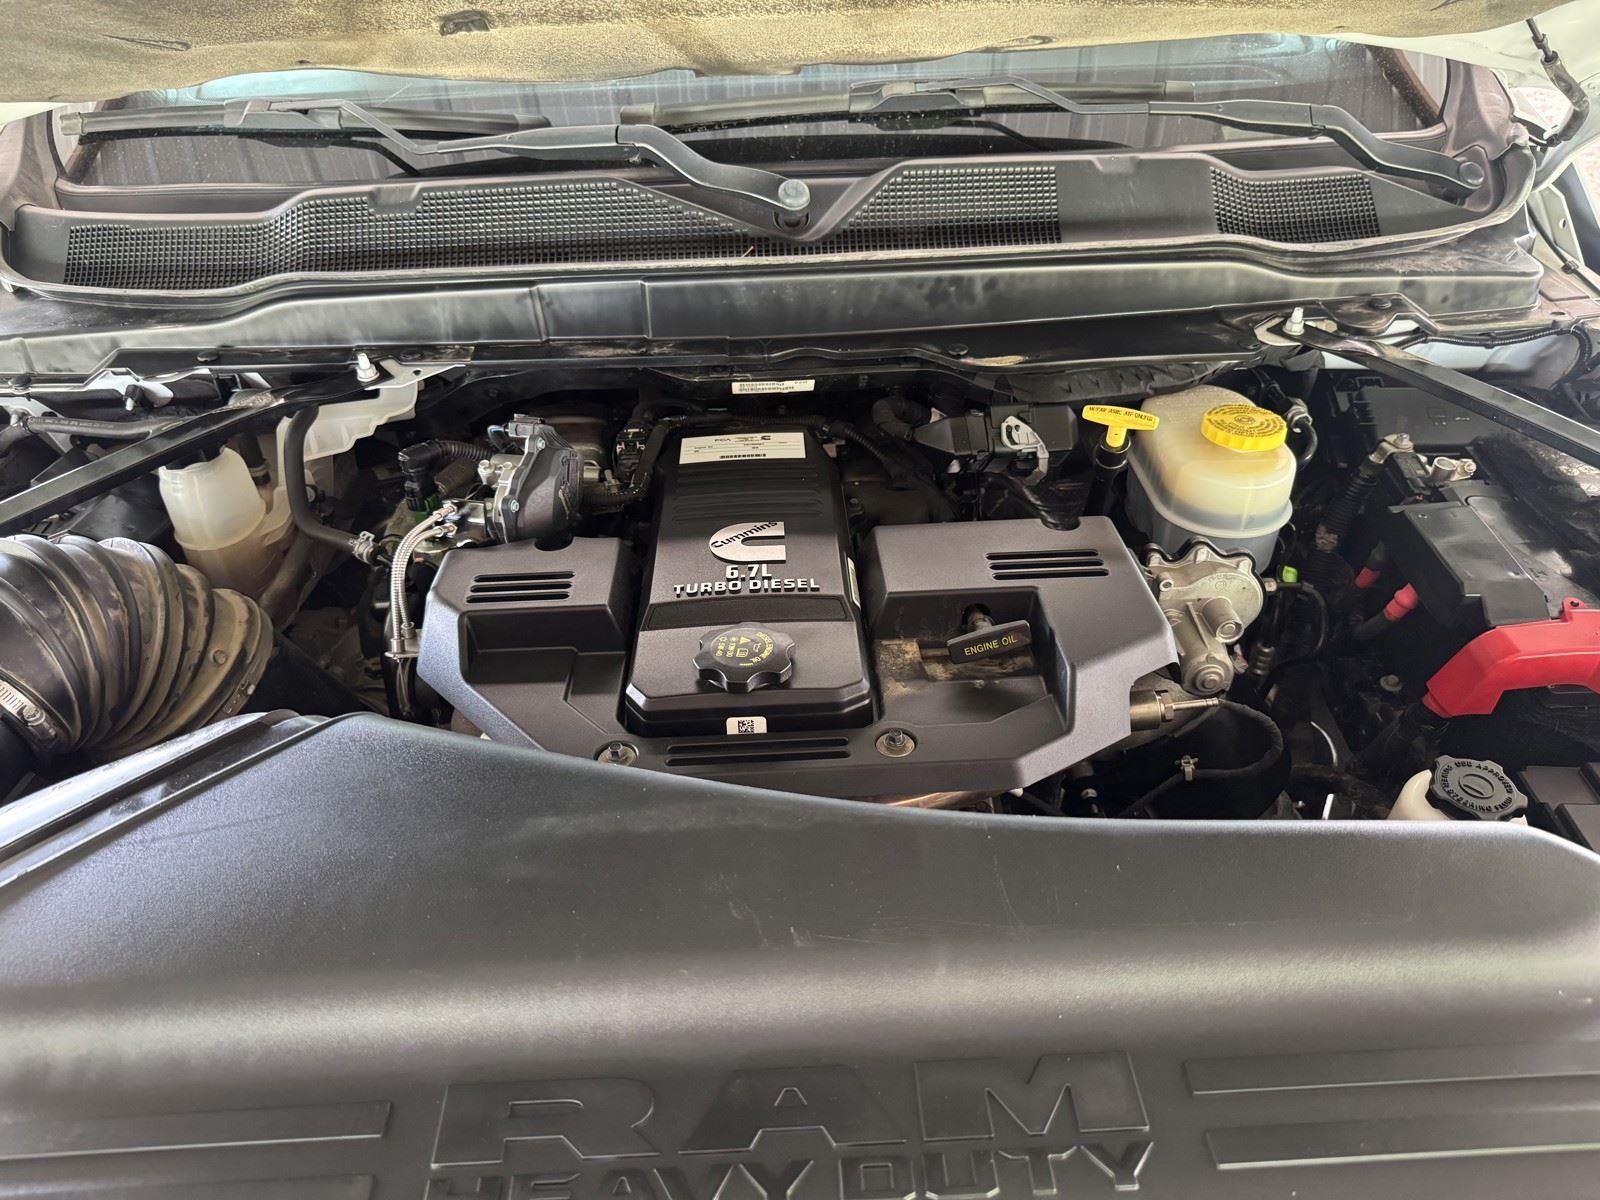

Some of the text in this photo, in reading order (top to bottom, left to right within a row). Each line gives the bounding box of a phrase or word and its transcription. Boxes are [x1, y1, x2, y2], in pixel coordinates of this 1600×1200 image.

[711, 521, 778, 548] Cummins
[725, 563, 773, 581] 6.7L
[673, 577, 820, 599] TURBO DIESEL
[963, 635, 1018, 656] ENGINE OIL
[430, 1050, 1151, 1169] RAM
[838, 1140, 1154, 1200] DUTY
